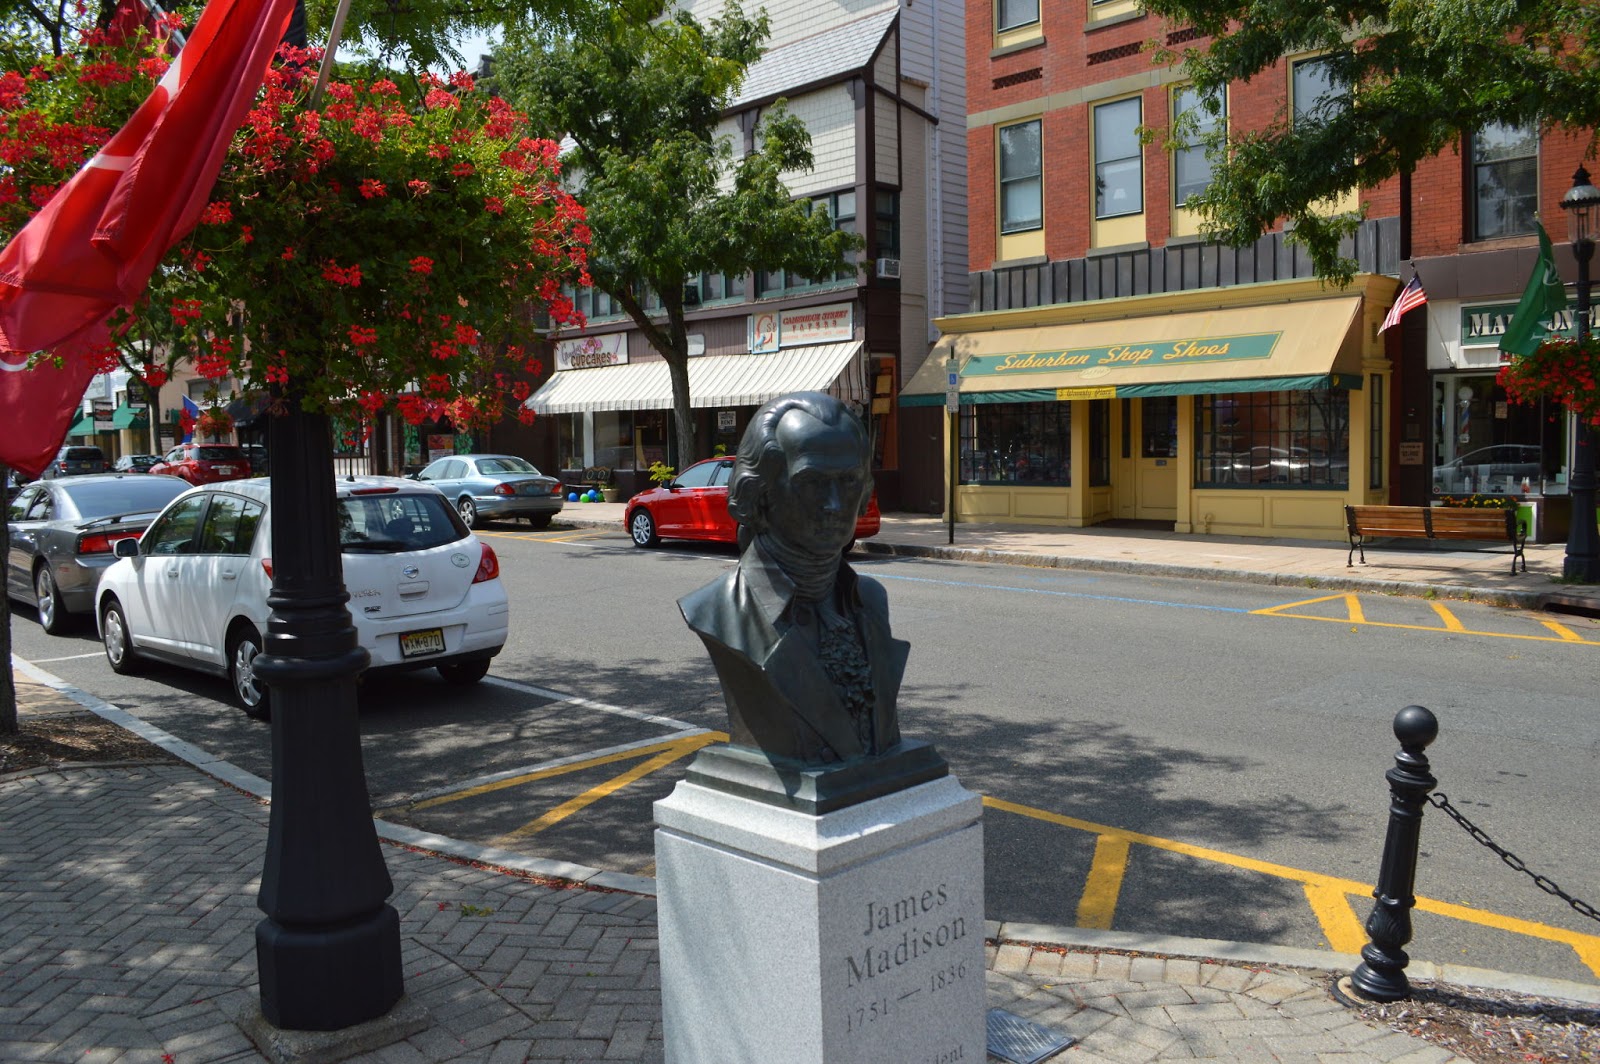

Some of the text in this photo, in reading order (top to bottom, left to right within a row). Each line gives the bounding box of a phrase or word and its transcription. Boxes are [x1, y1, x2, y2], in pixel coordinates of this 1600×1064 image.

[1469, 309, 1577, 337] MAON
[995, 341, 1230, 371] Suburban Shop Shoes
[863, 883, 948, 936] James
[844, 916, 966, 988] Madison
[846, 998, 888, 1033] 1751
[931, 959, 966, 992] 1836
